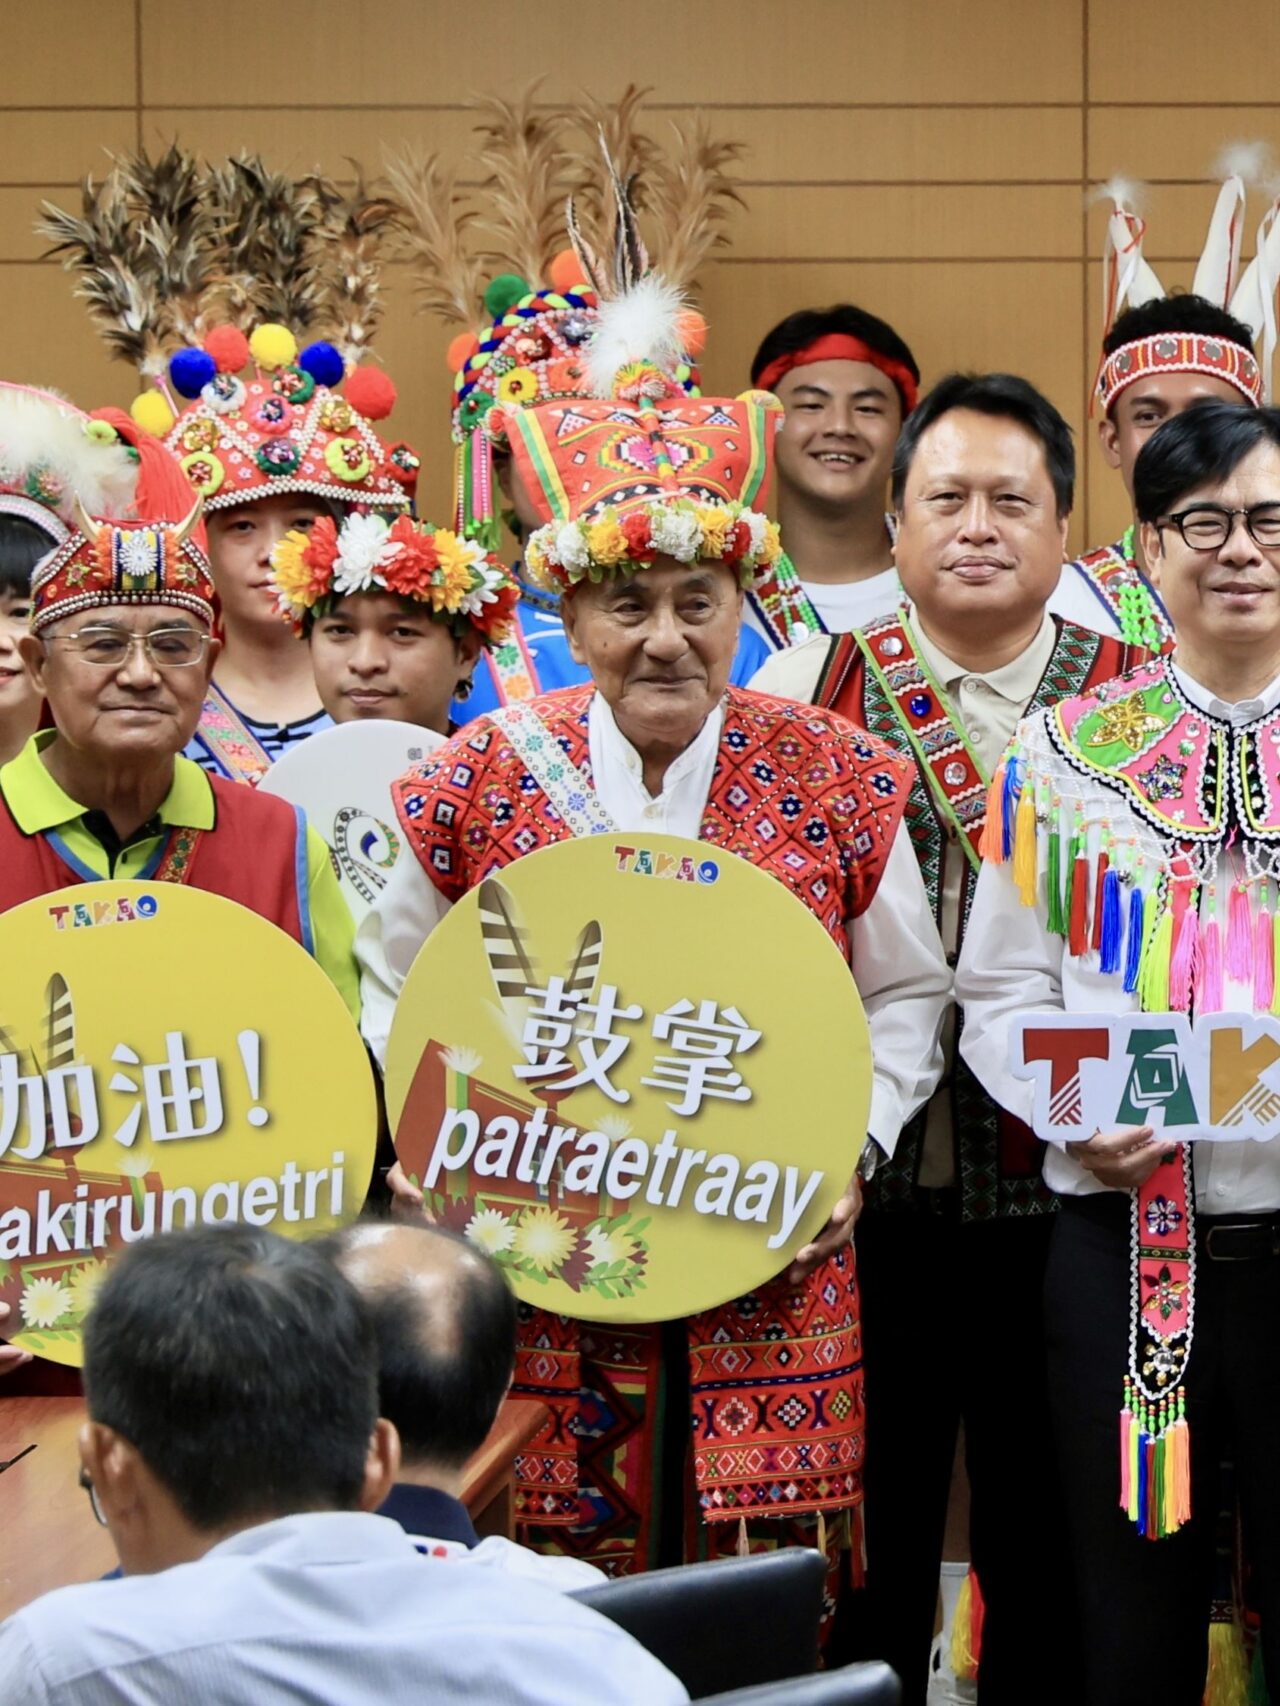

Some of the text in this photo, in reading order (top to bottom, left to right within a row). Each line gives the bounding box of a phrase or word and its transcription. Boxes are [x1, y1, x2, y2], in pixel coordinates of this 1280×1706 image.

[613, 845, 720, 886] TAKAO
[49, 894, 158, 929] TAKAO
[512, 976, 762, 1116] 鼓掌
[424, 1107, 824, 1249] patraetraay
